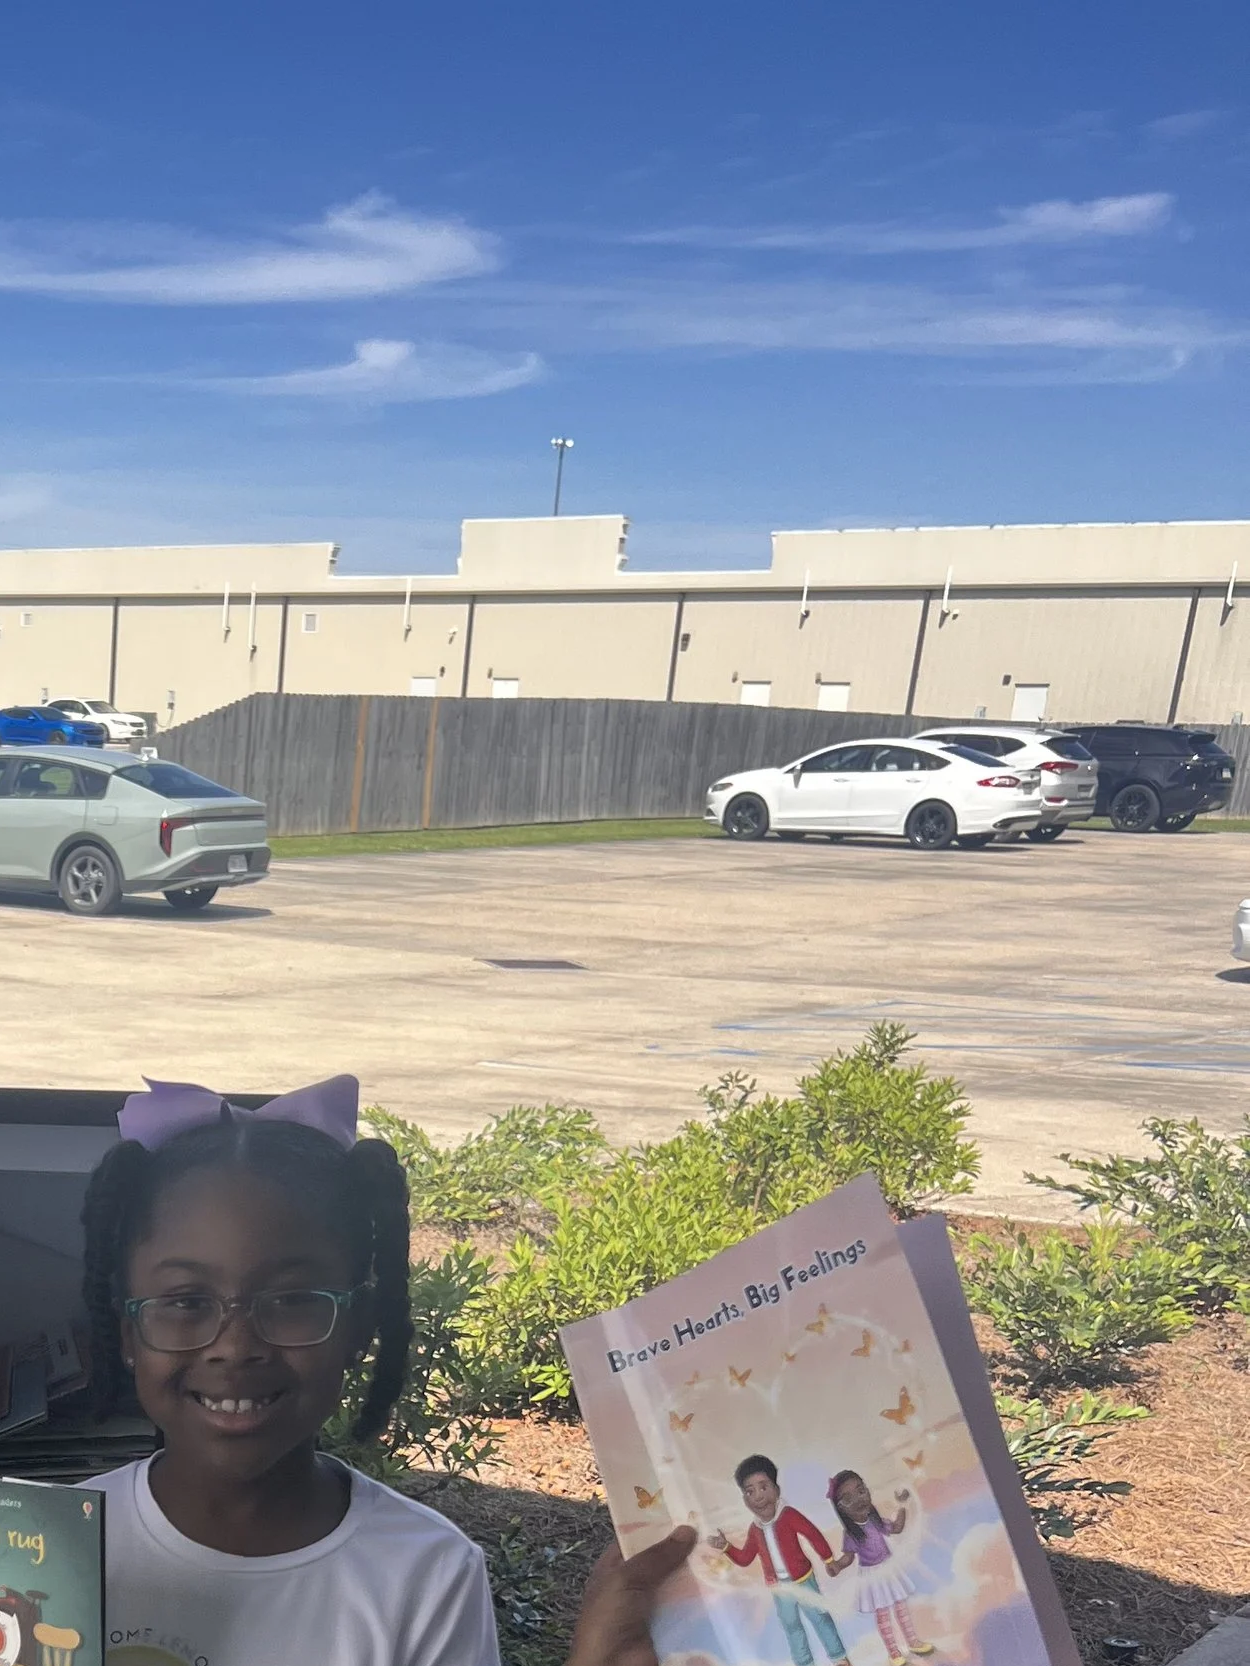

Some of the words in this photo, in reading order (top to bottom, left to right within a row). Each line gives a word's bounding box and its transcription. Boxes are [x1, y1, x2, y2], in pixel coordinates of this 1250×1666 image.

[606, 1337, 671, 1374] Brave
[672, 1301, 745, 1347] Hearts,
[744, 1282, 780, 1310] Big
[779, 1239, 867, 1293] Feelings
[7, 1530, 45, 1566] rug
